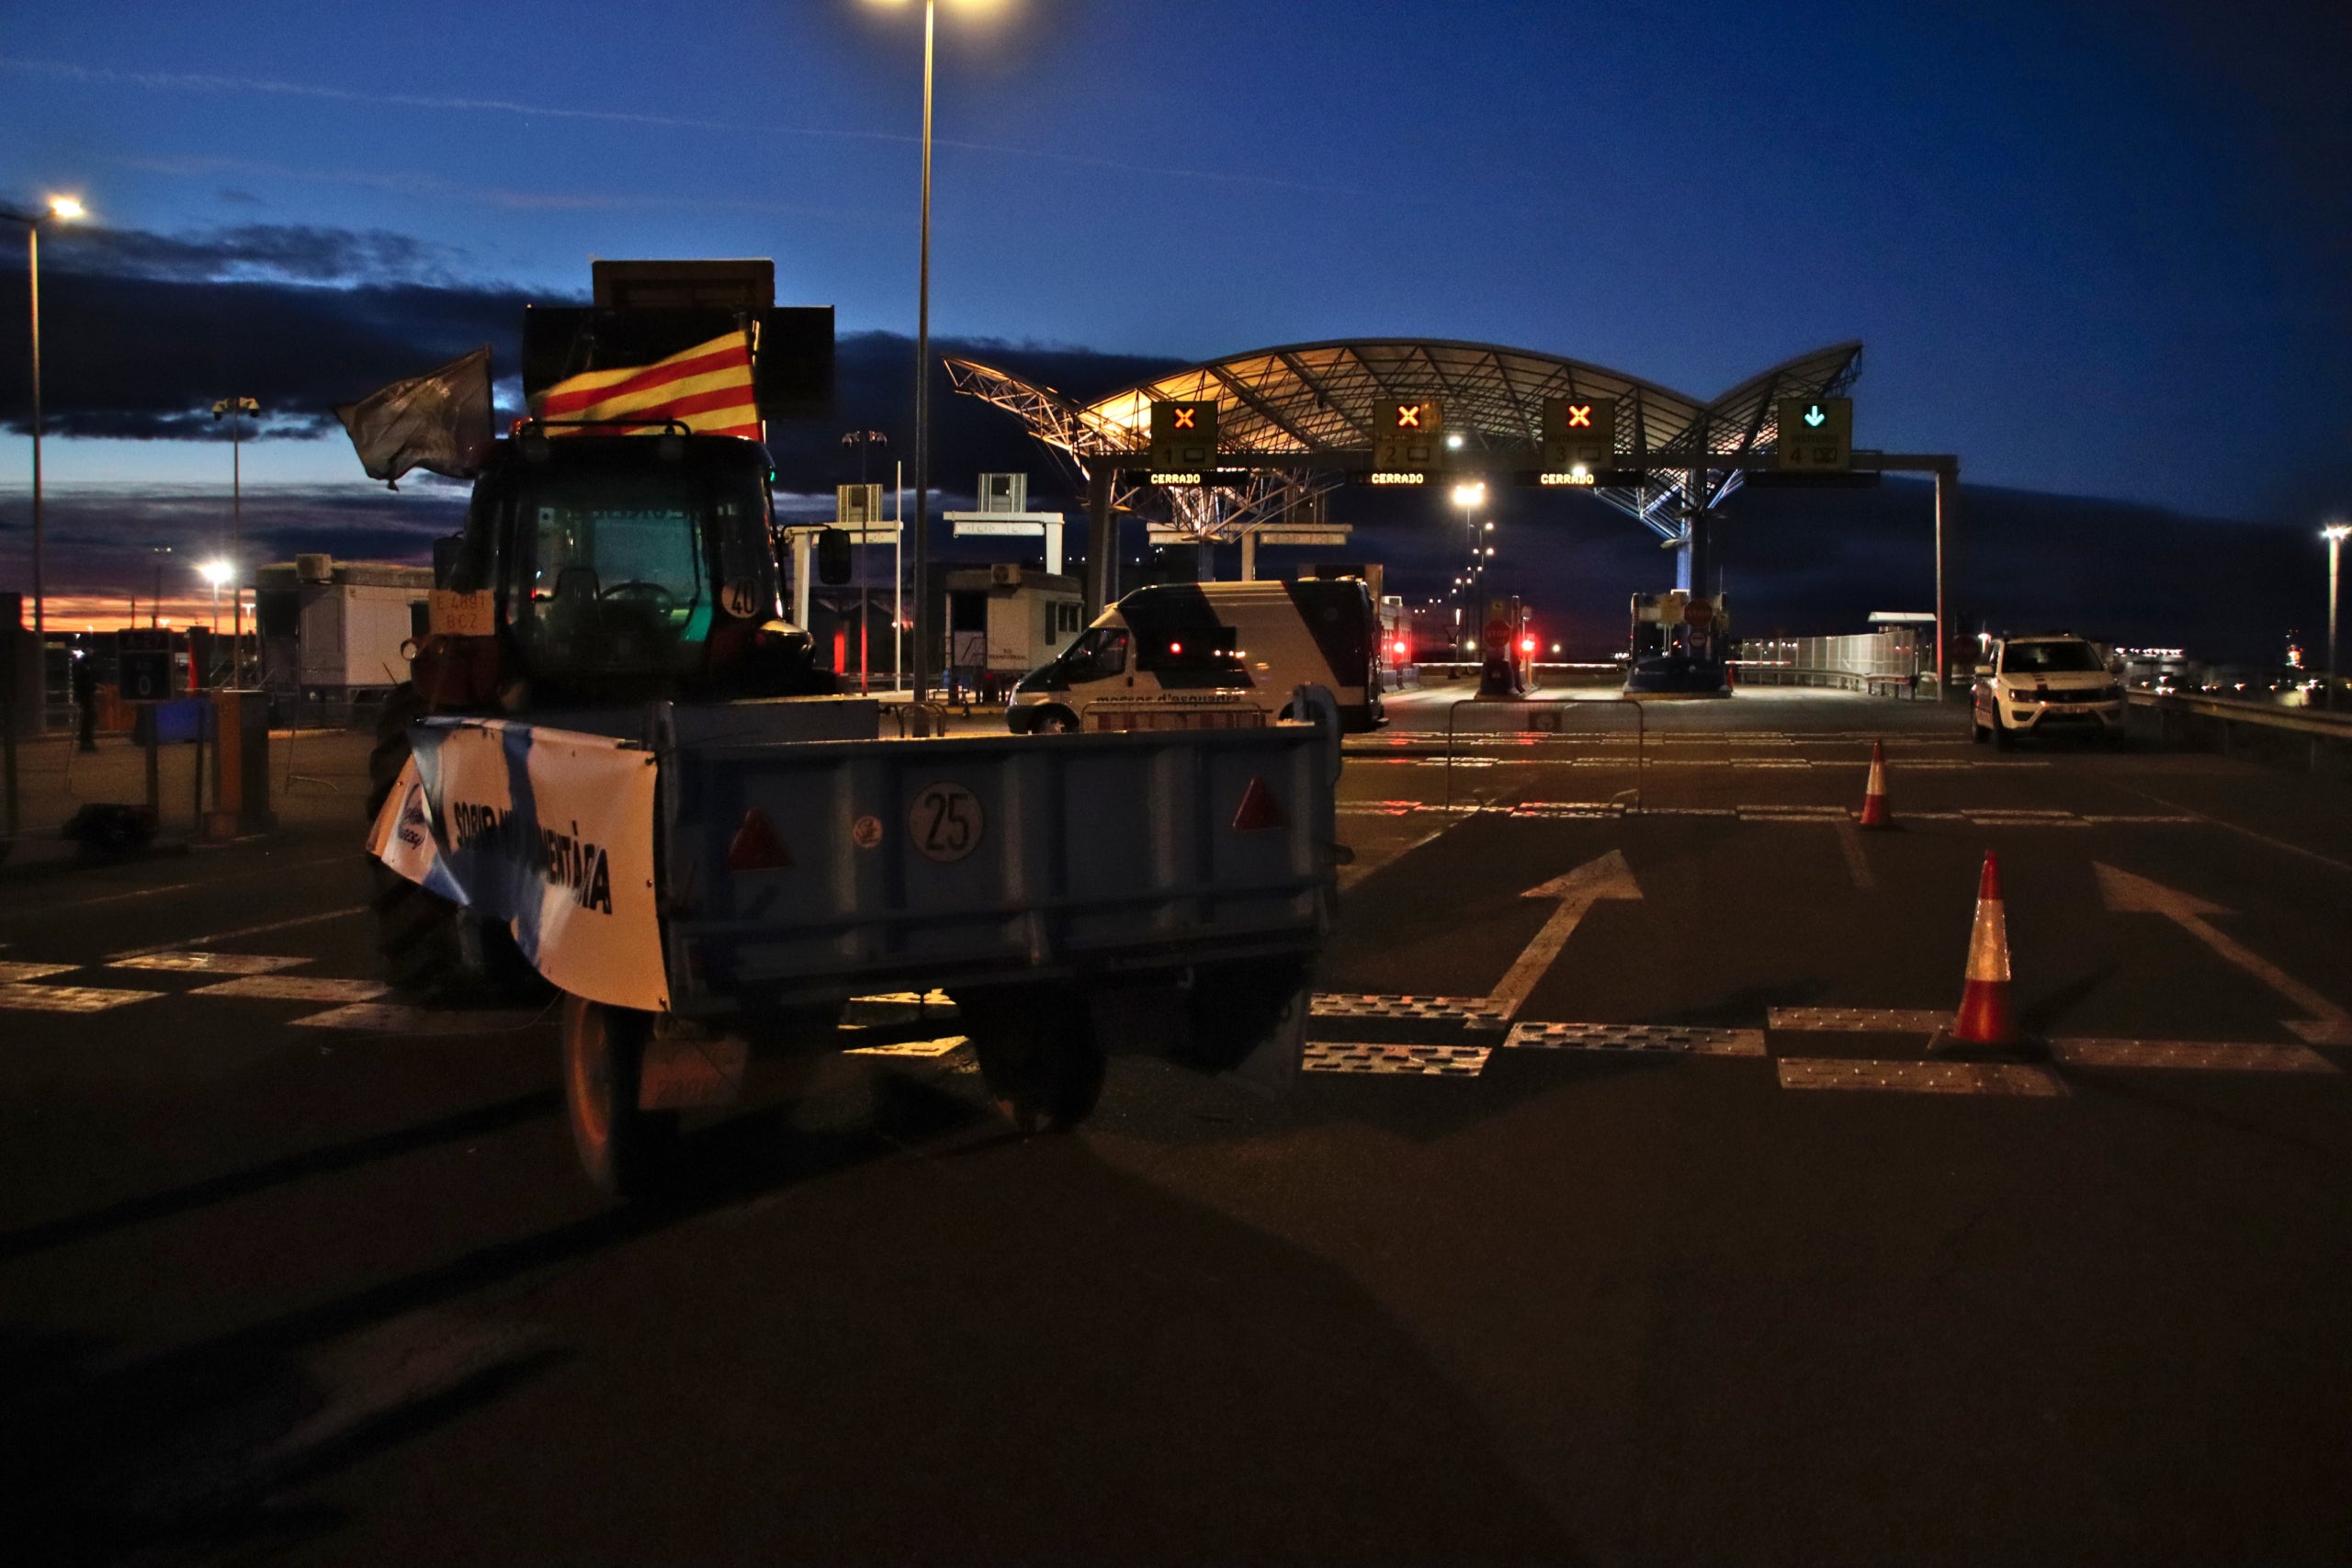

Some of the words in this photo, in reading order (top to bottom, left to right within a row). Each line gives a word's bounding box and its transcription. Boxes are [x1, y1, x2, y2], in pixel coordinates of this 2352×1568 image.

[1163, 448, 1171, 464] 1
[1385, 446, 1396, 463] 2
[1556, 446, 1566, 463] 3
[1790, 446, 1803, 463] 4
[1150, 473, 1201, 484] CERRADO
[1372, 473, 1424, 484] CERRADO
[1540, 473, 1595, 484] CERRADO
[731, 580, 755, 614] 40
[1687, 609, 1711, 618] STOP
[1486, 629, 1509, 638] STOP
[924, 792, 969, 851] 25
